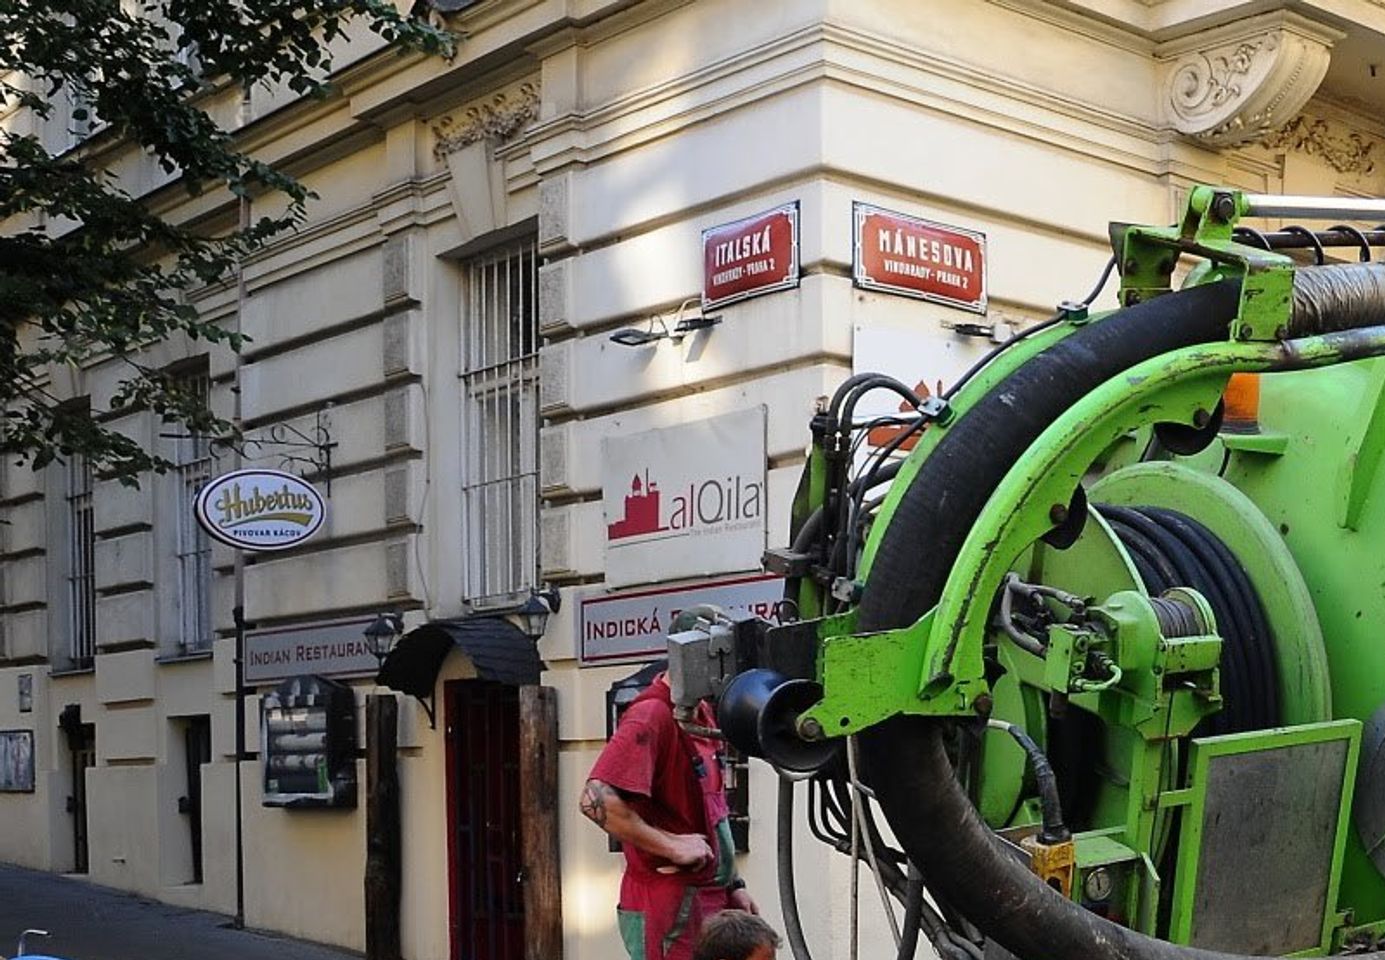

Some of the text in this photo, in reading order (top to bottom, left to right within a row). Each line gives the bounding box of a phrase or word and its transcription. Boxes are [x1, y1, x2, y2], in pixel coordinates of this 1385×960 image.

[715, 225, 771, 268] ITALSKÁ
[878, 228, 973, 273] MÁNESOVA
[746, 260, 769, 276] PRAHA
[769, 258, 775, 271] 2
[884, 259, 931, 280] VINOHRADY
[936, 270, 962, 287] PRAHA
[962, 276, 969, 289] 2
[215, 482, 313, 522] Hubertus
[586, 607, 661, 640] INDICKÁ
[250, 650, 290, 666] INDIAN
